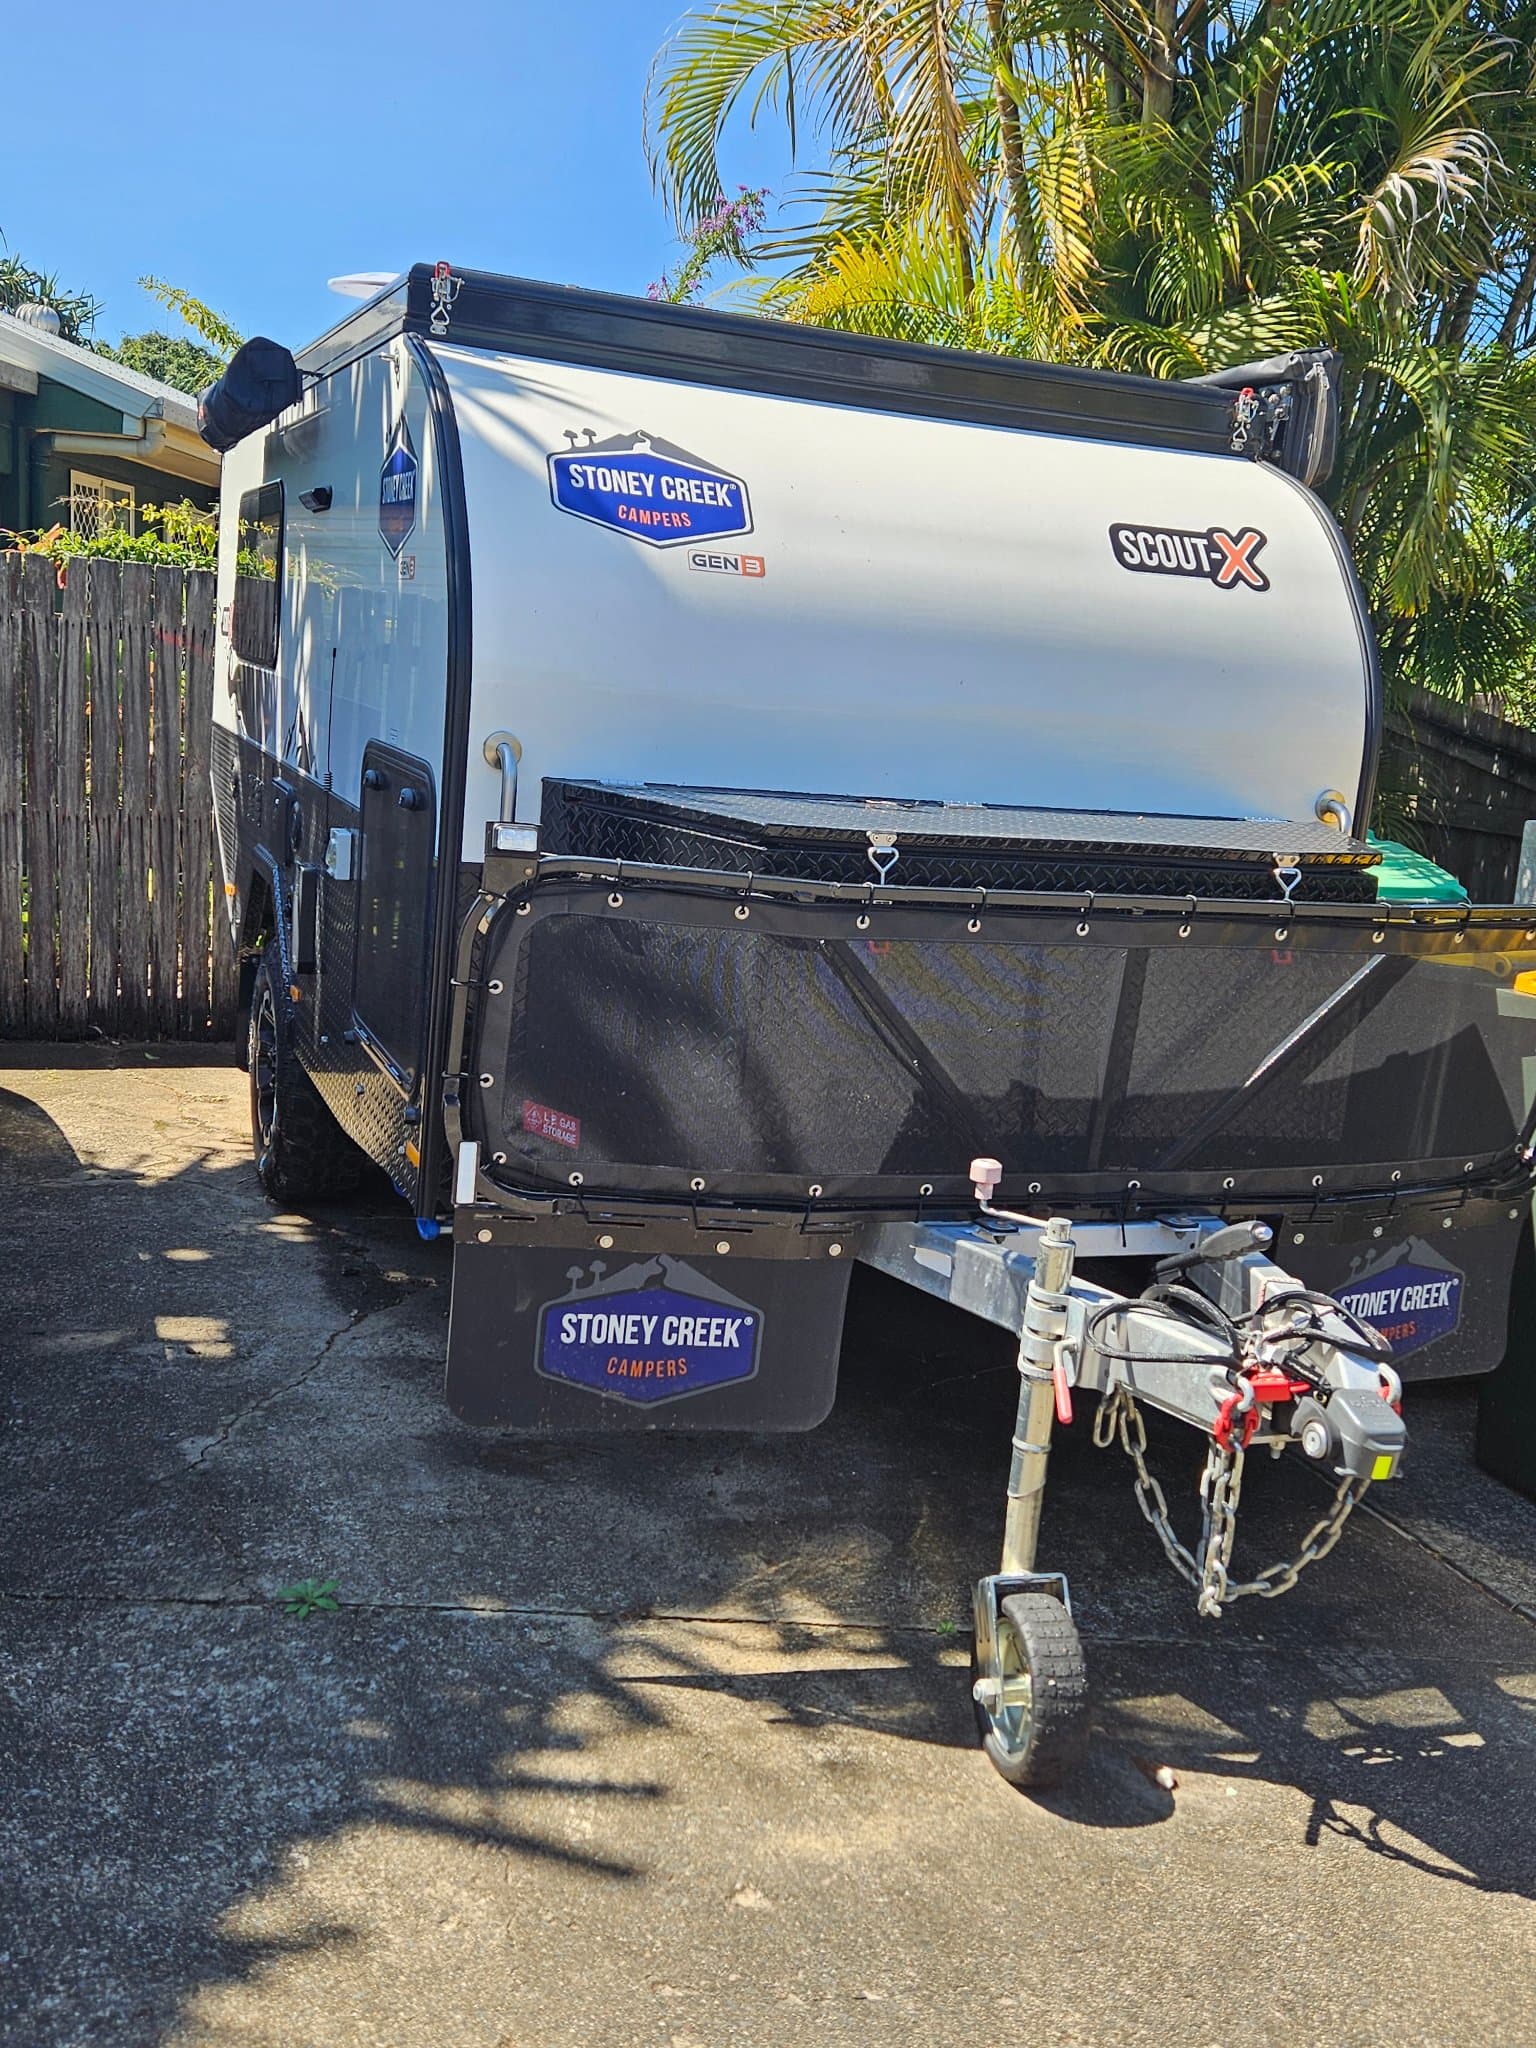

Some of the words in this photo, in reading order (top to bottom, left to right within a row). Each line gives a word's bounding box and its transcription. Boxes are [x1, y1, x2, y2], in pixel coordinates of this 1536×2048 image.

[568, 463, 654, 497] STONEY
[660, 476, 733, 508] CREEK
[618, 504, 692, 527] CAMPERS
[1118, 529, 1264, 586] SCOUT-X
[543, 1123, 577, 1145] STORAGE
[560, 1118, 577, 1132] GAS
[1400, 1280, 1452, 1312] CREEK
[560, 1313, 659, 1345] STONEY
[662, 1316, 742, 1348] CREEK
[1376, 1321, 1416, 1341] MPERS
[607, 1356, 688, 1378] CAMPERS
